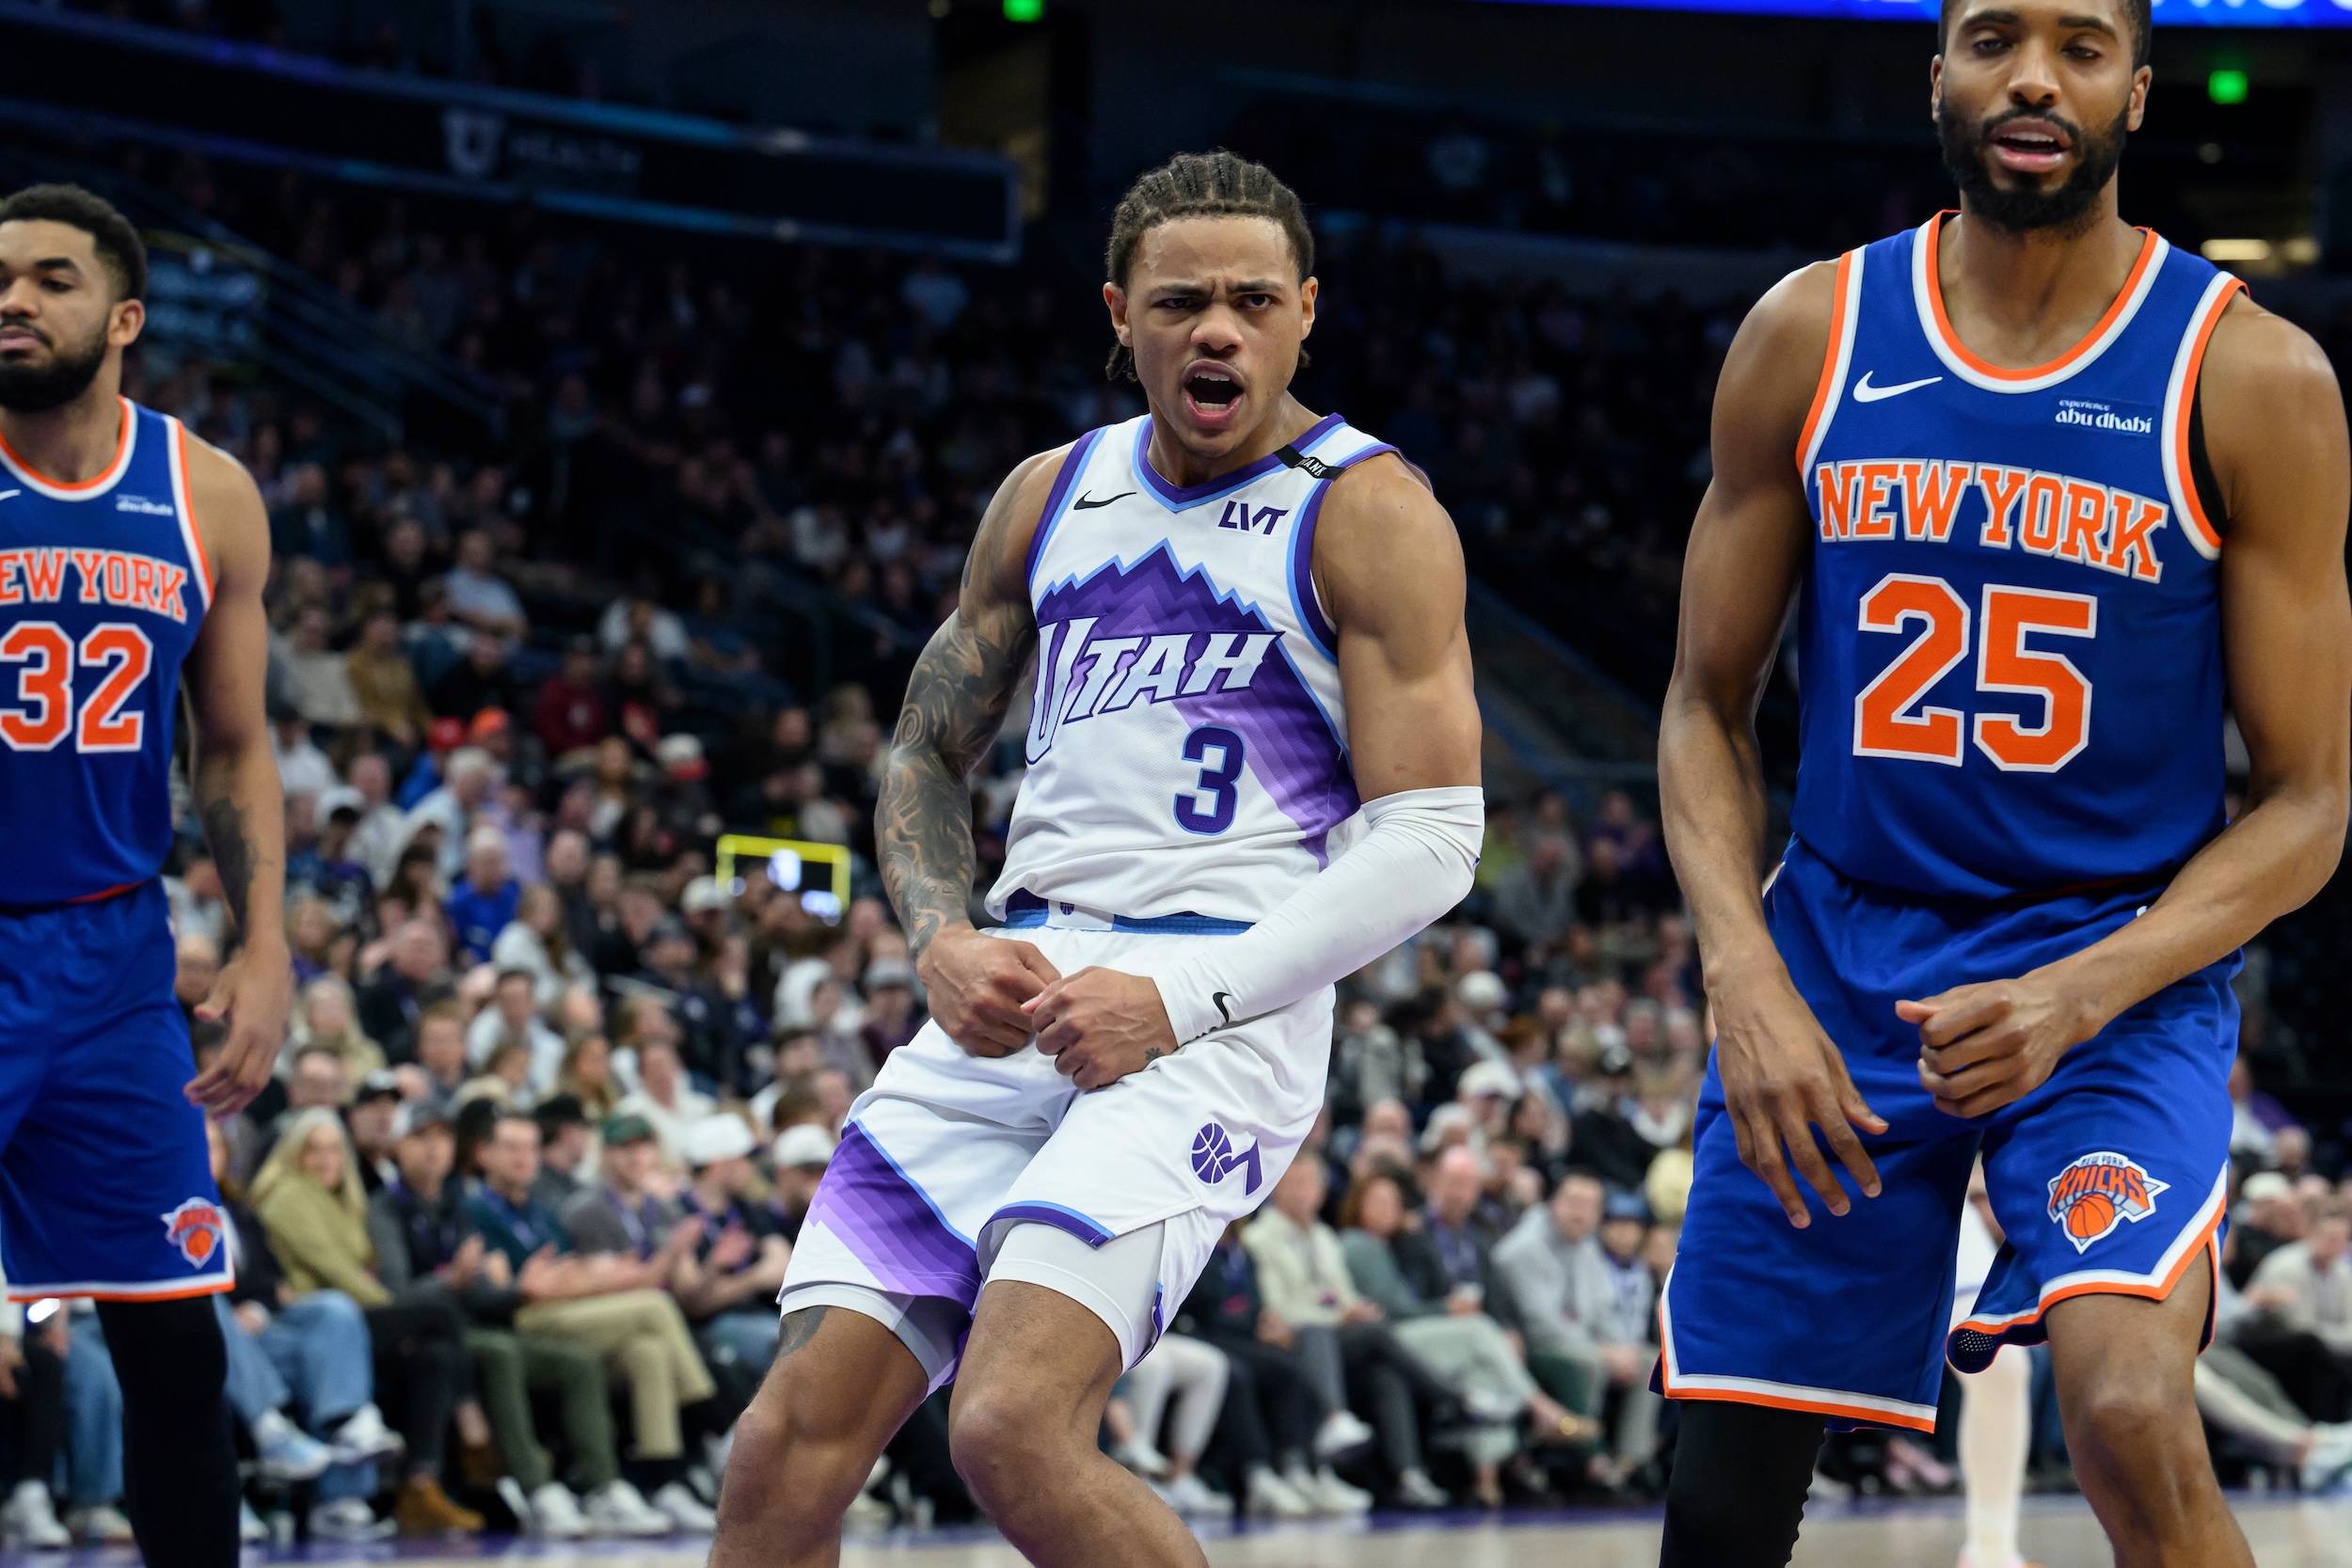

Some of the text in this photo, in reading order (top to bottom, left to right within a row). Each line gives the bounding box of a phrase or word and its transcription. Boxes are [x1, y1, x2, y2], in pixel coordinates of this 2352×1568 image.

[2055, 408, 2153, 434] abu dhabi
[2058, 400, 2110, 411] experience
[1218, 500, 1289, 535] LVT
[1816, 458, 2169, 584] NEW YORK
[0, 547, 188, 626] EW YORK
[0, 621, 153, 753] 32
[1025, 614, 1286, 766] UTAH
[1852, 573, 2098, 774] 25
[1173, 724, 1247, 836] 3
[2049, 1164, 2151, 1211] KNICKS
[2079, 1155, 2123, 1167] NEW YORK
